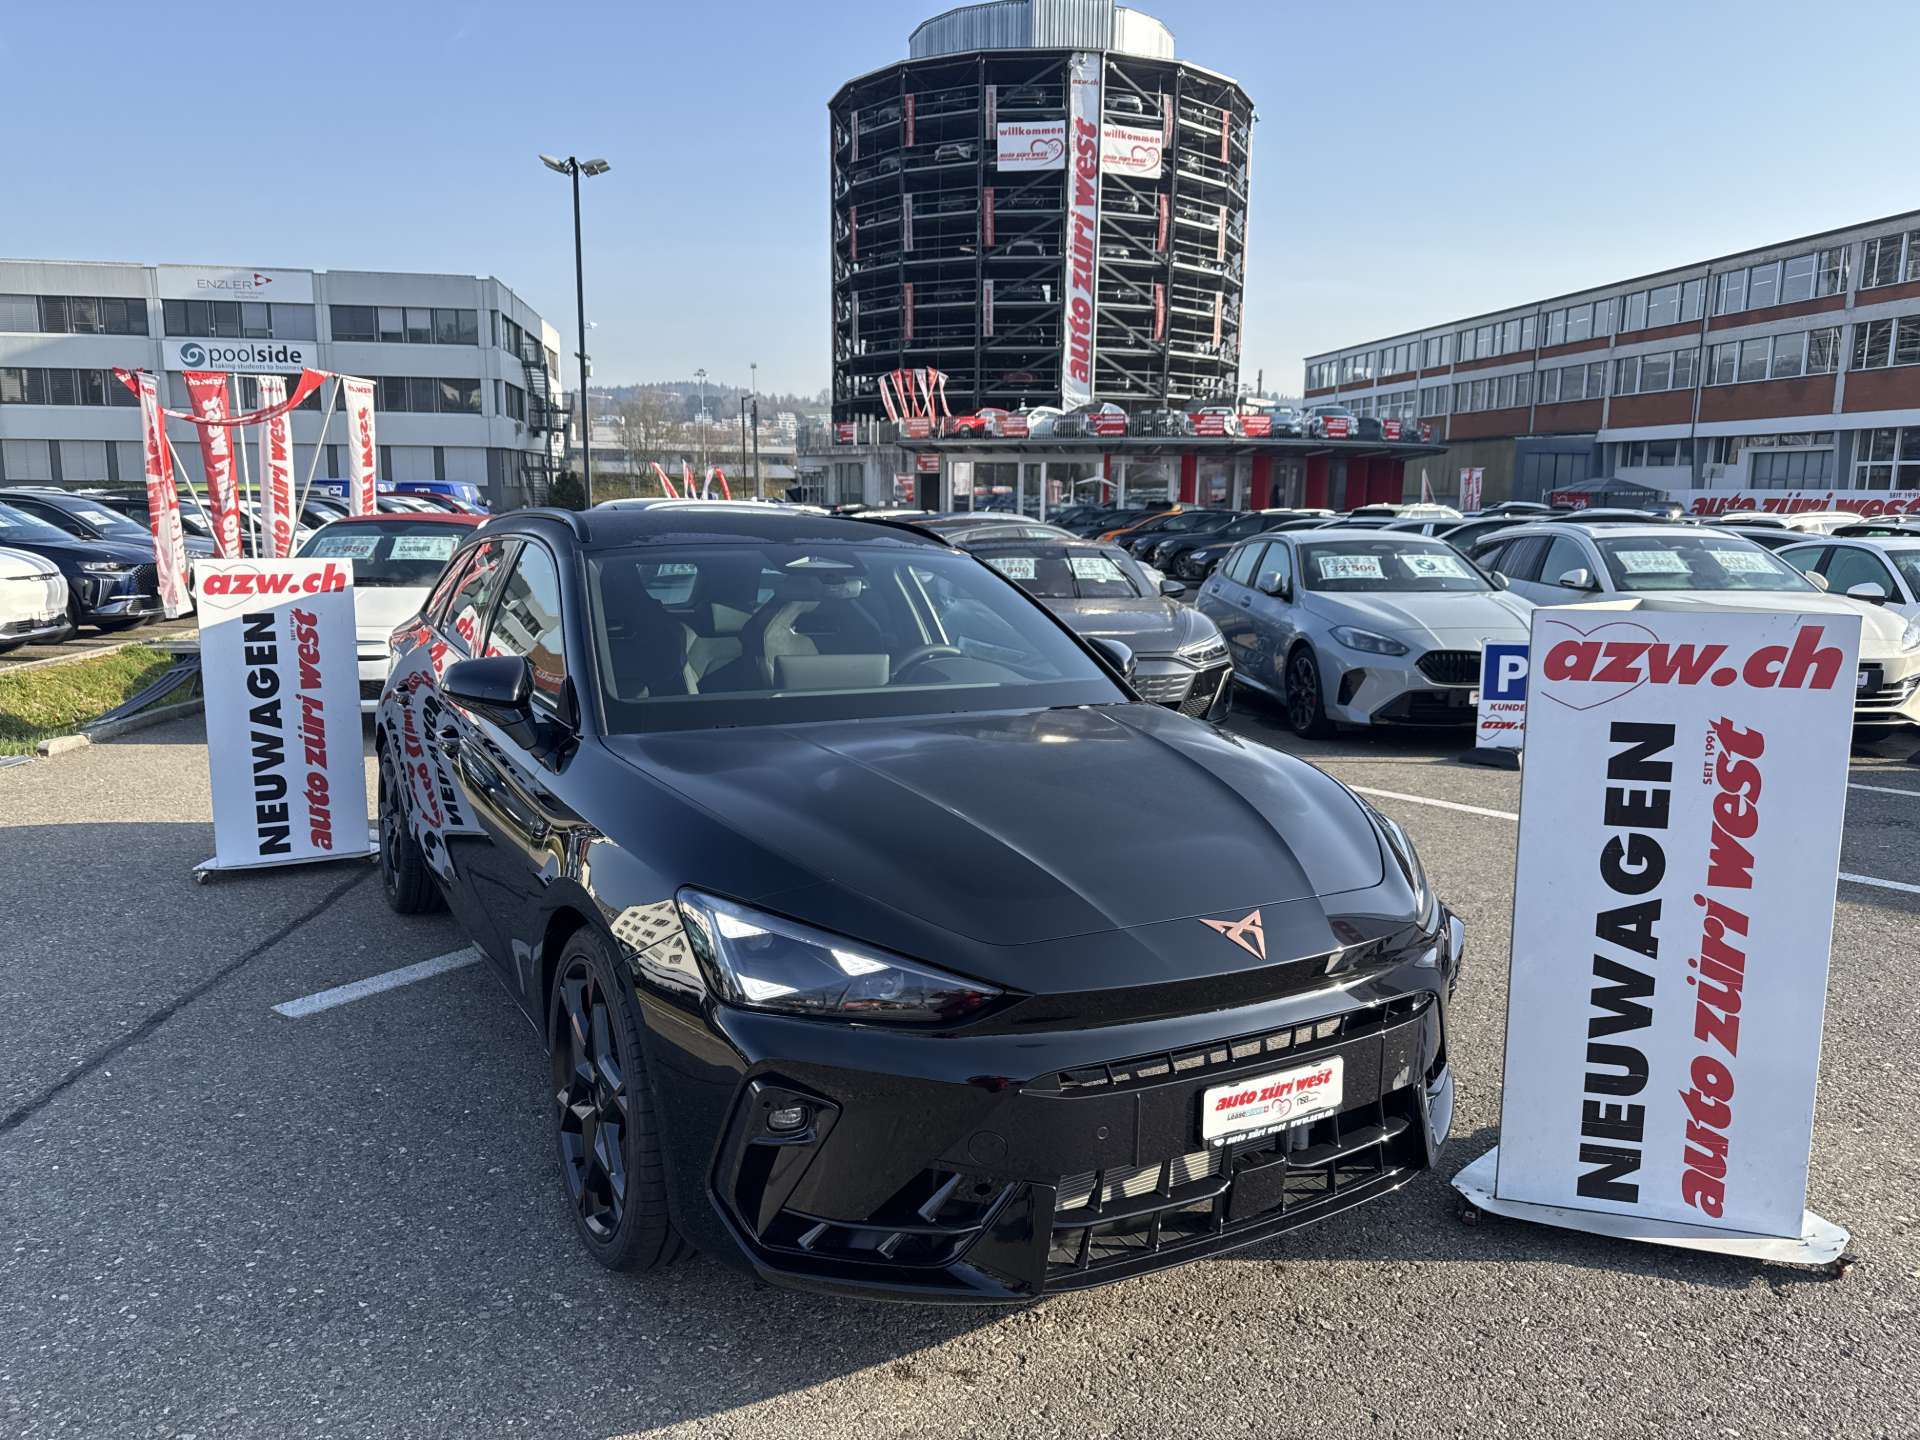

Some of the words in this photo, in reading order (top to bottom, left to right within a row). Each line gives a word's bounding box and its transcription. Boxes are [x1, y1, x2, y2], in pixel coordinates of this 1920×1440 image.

[999, 126, 1064, 136] willkommen
[1103, 130, 1161, 144] willkommen
[1074, 116, 1097, 206] west
[1070, 210, 1095, 296] züri
[197, 279, 252, 290] ENZLER
[209, 344, 303, 368] poolside
[1068, 297, 1091, 383] auto
[237, 363, 265, 371] students
[270, 415, 287, 461] wes
[268, 463, 289, 520] züri
[1690, 492, 1756, 515] auto
[1762, 492, 1833, 513] züri
[272, 520, 290, 559] uto
[203, 563, 347, 595] azw.ch
[291, 608, 321, 689] west
[1543, 626, 1844, 690] azw.ch
[1498, 655, 1528, 692] P
[242, 612, 292, 856] NEUWAGEN
[296, 694, 327, 769] züri
[1704, 730, 1717, 756] 1991
[1703, 761, 1714, 785] SEIT
[302, 772, 333, 850] auto
[1707, 716, 1765, 890] west
[1576, 722, 1676, 1203] NEUWAGEN
[1686, 893, 1750, 1058] züri
[1216, 1090, 1258, 1112] auto
[1259, 1078, 1295, 1102] züri
[1296, 1068, 1333, 1092] west
[1226, 1134, 1246, 1145] auto
[1247, 1127, 1266, 1140] züri
[1267, 1122, 1286, 1134] west
[1681, 1055, 1735, 1219] auto
